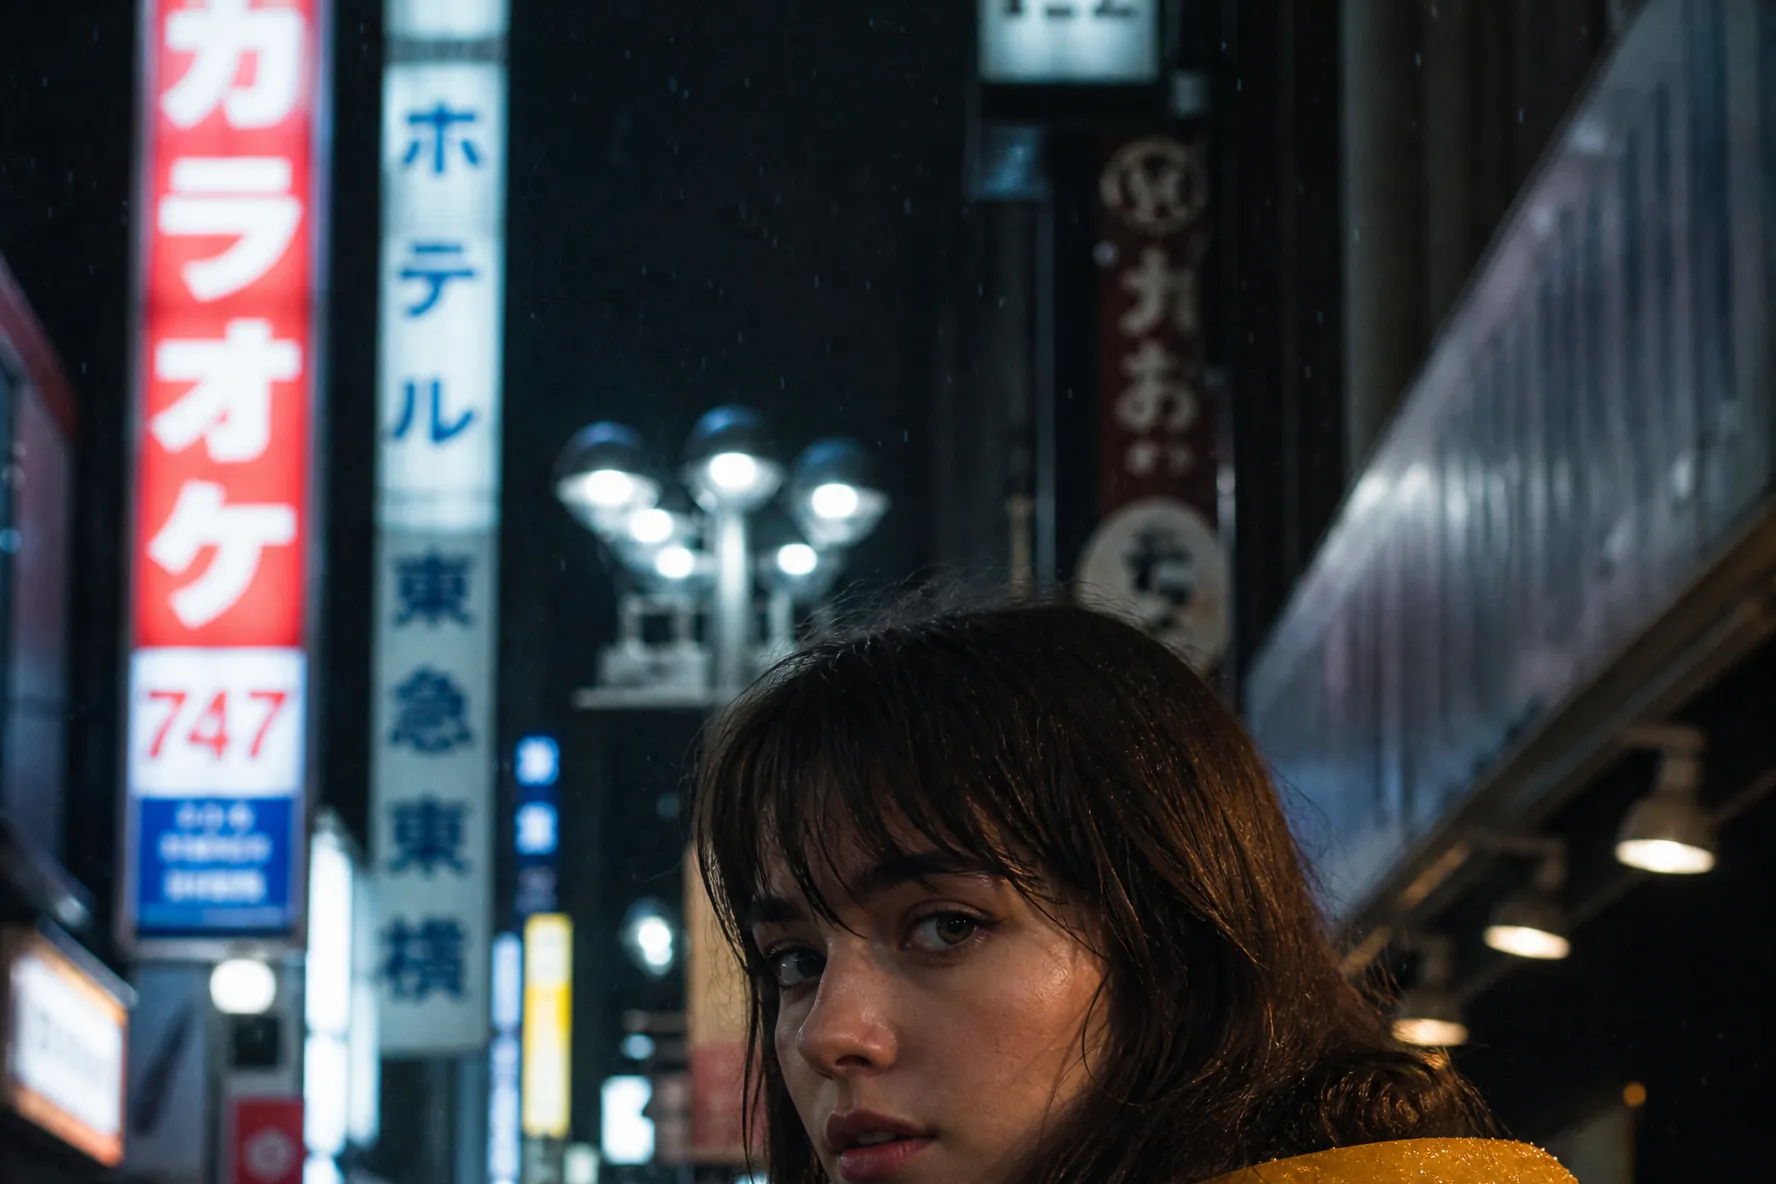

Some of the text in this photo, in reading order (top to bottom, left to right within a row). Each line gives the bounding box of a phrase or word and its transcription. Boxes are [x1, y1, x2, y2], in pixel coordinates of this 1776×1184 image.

[146, 0, 304, 627] カラオケ
[394, 103, 481, 443] ホテル
[148, 688, 289, 758] 747
